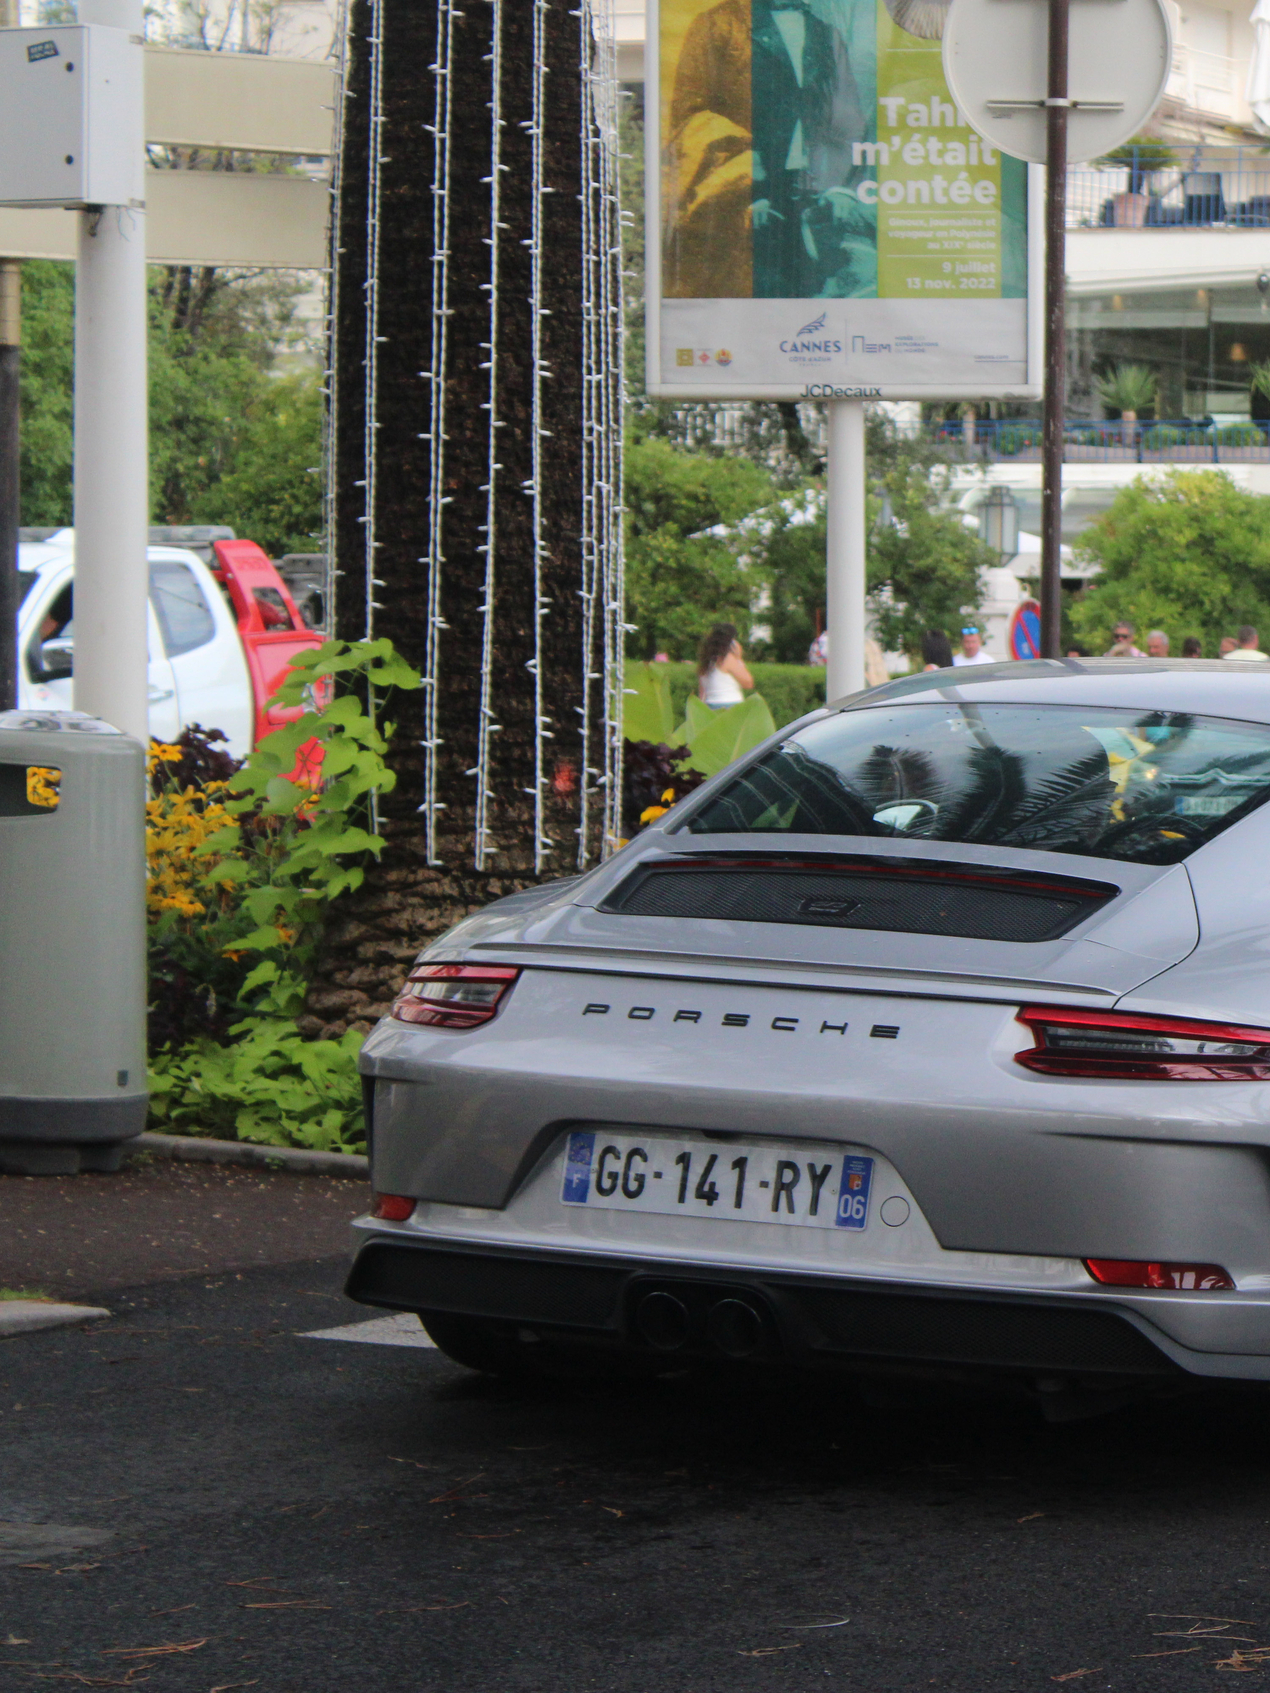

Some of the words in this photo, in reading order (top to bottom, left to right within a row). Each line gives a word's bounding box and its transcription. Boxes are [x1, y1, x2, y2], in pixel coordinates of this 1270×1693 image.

[857, 171, 997, 204] contée
[929, 217, 983, 228] journaliste
[985, 218, 996, 227] et
[888, 230, 934, 239] voyageur
[949, 229, 996, 239] Polynésie
[966, 240, 996, 249] siècle
[942, 261, 952, 273] 9
[954, 261, 996, 275] juillet
[906, 277, 921, 289] 13
[924, 279, 956, 289] nov.
[959, 277, 996, 289] 2022
[779, 340, 842, 353] CANNES
[800, 384, 882, 398] JCDecaux
[582, 1003, 901, 1040] PORSCHE
[572, 1172, 582, 1188] F
[595, 1145, 832, 1216] GG-141-RY
[839, 1194, 866, 1220] 06
